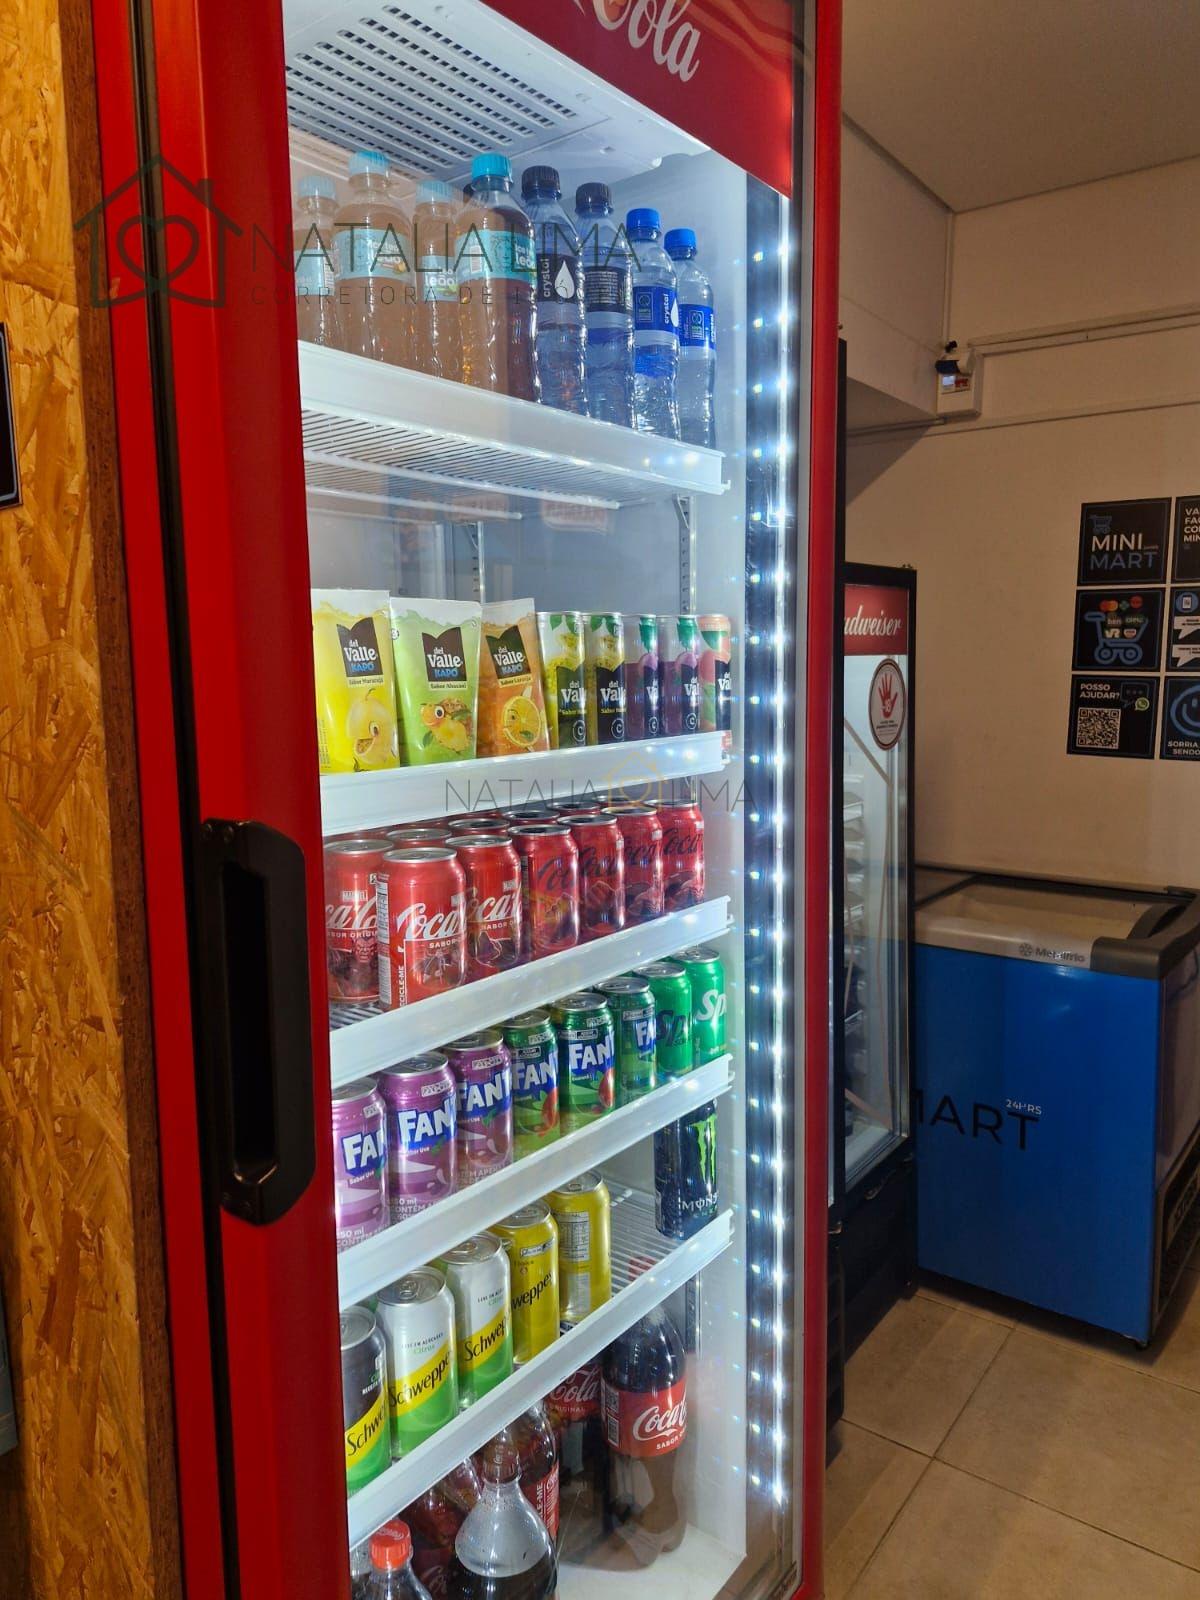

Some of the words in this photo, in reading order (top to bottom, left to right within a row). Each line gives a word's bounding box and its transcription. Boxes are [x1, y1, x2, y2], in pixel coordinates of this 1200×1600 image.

[1091, 532, 1143, 552] MINI
[1089, 551, 1158, 571] MART
[844, 605, 902, 637] udweiser
[343, 646, 378, 661] Valle
[427, 653, 463, 668] Valle
[493, 651, 525, 667] Valle
[1080, 683, 1111, 691] POSSO
[1079, 691, 1120, 700] AJUDAR?
[1005, 1098, 1042, 1116] 24HRS
